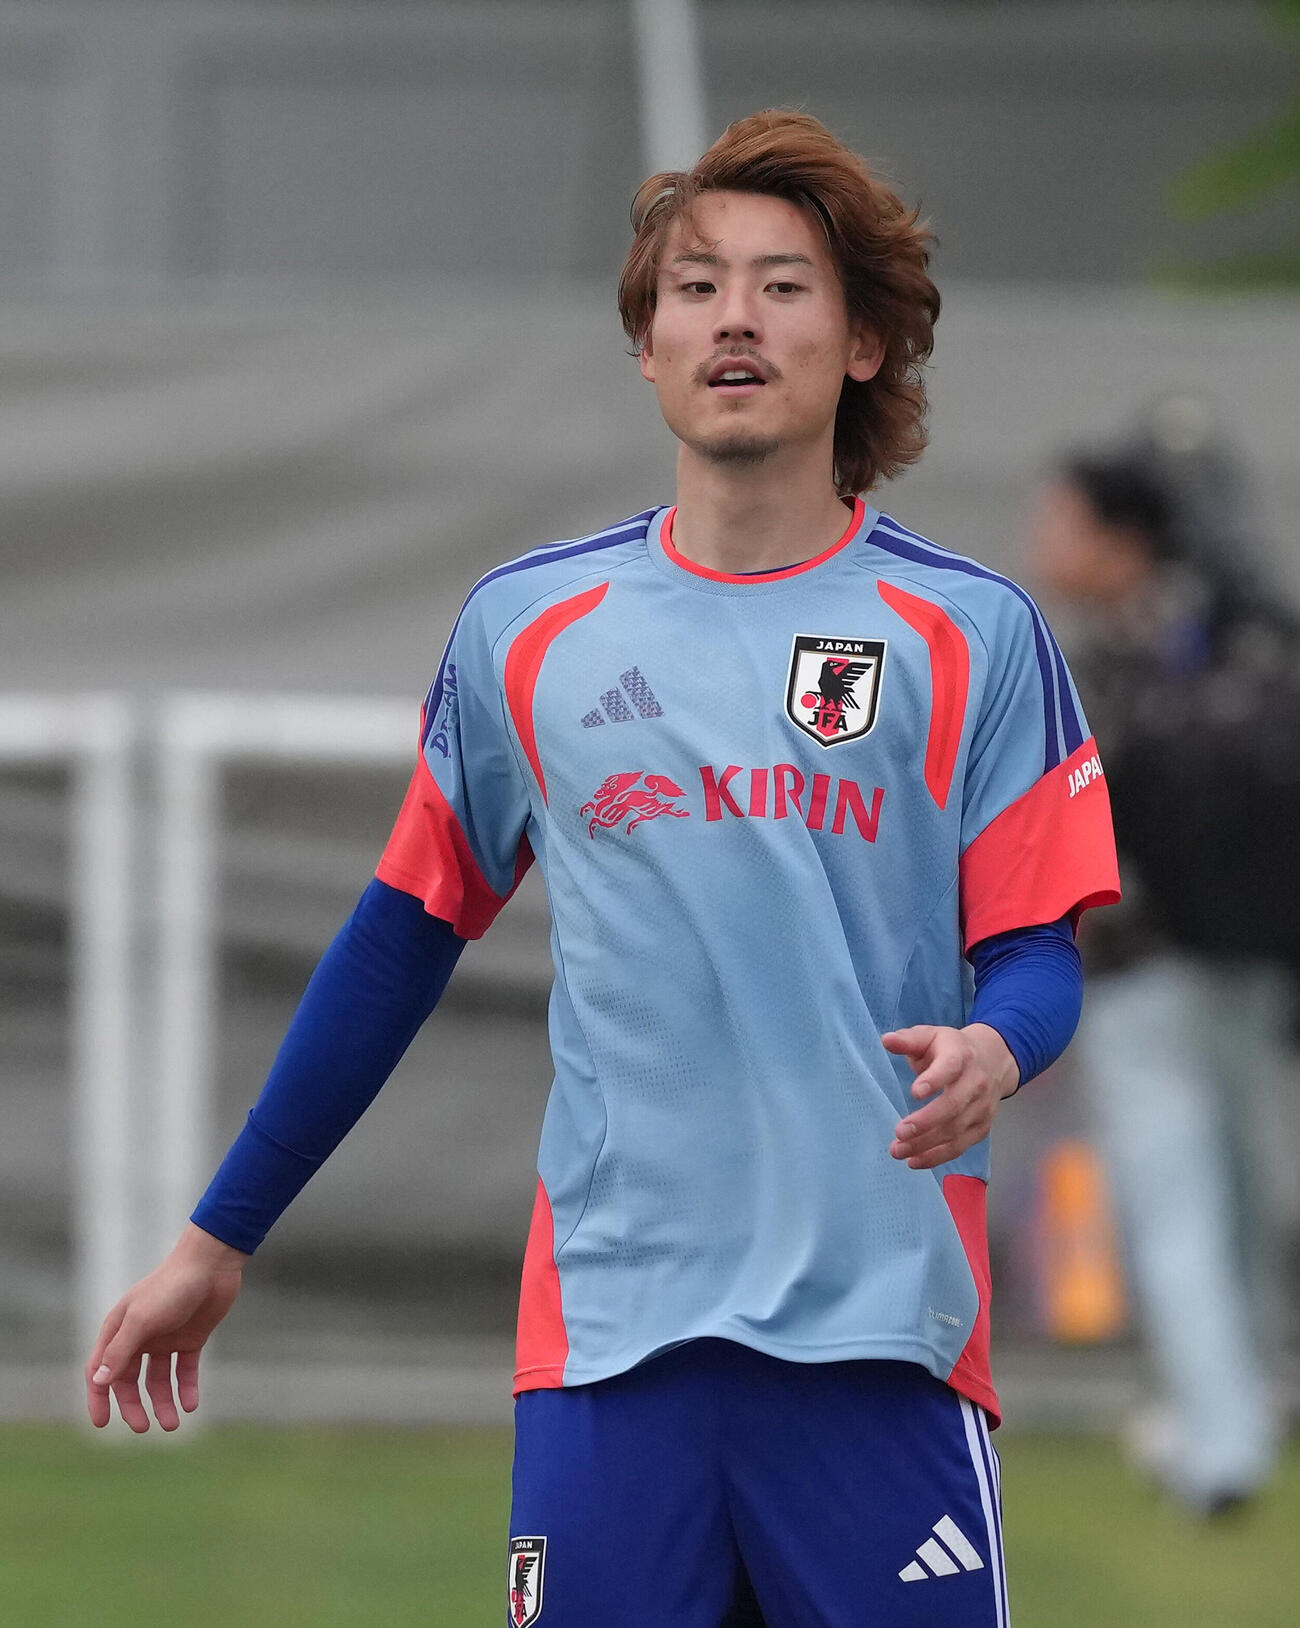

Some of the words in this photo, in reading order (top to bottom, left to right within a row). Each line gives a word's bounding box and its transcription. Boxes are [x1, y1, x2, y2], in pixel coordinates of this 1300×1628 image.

[816, 641, 863, 653] JAPAN
[807, 711, 848, 731] JFA
[699, 763, 885, 843] KIRIN
[515, 1541, 533, 1550] JAPAN
